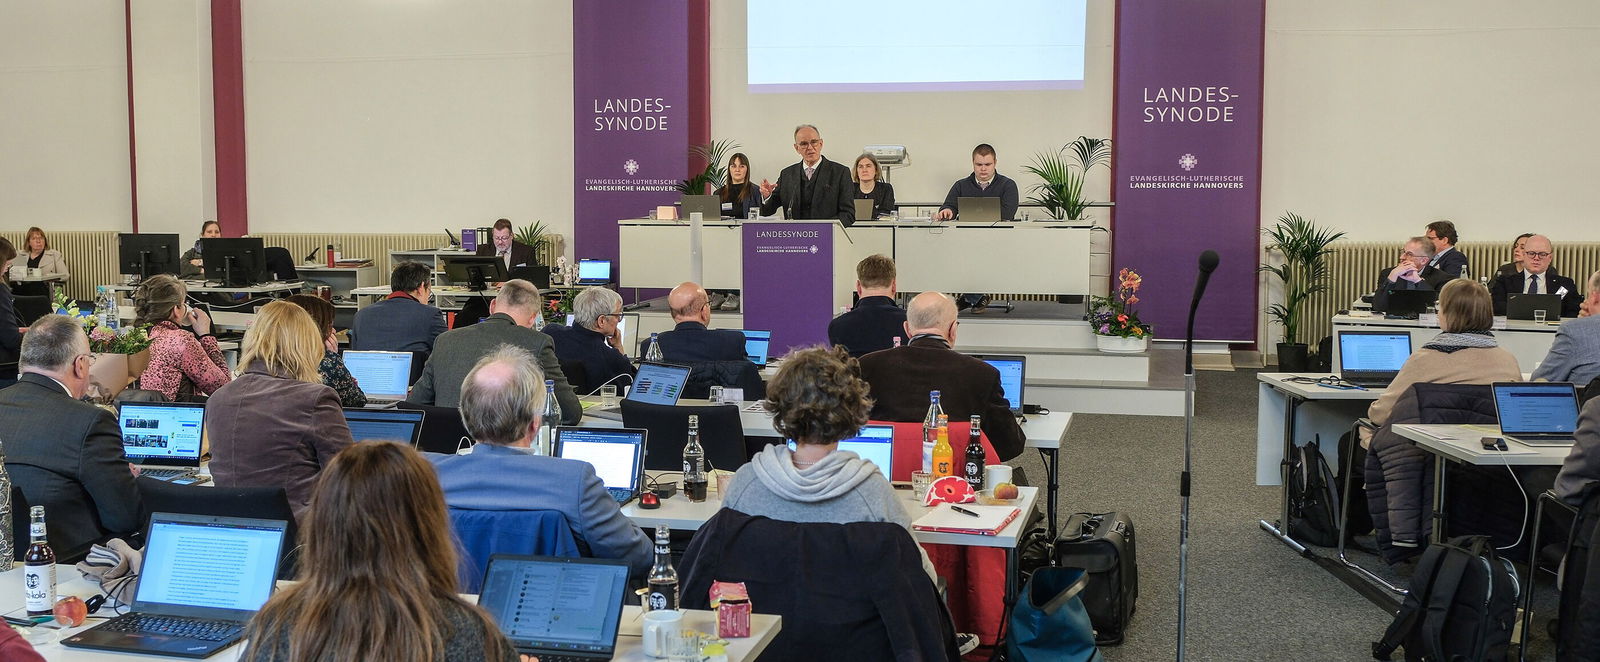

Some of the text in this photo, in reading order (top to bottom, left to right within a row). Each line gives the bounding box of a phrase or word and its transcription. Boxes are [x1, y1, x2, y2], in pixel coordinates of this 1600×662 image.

[1143, 86, 1240, 103] LANDES-
[594, 98, 672, 113] LANDES-
[1143, 106, 1235, 122] SYNODE
[594, 116, 669, 131] SYNODE
[756, 230, 819, 238] LANDESSYNODE
